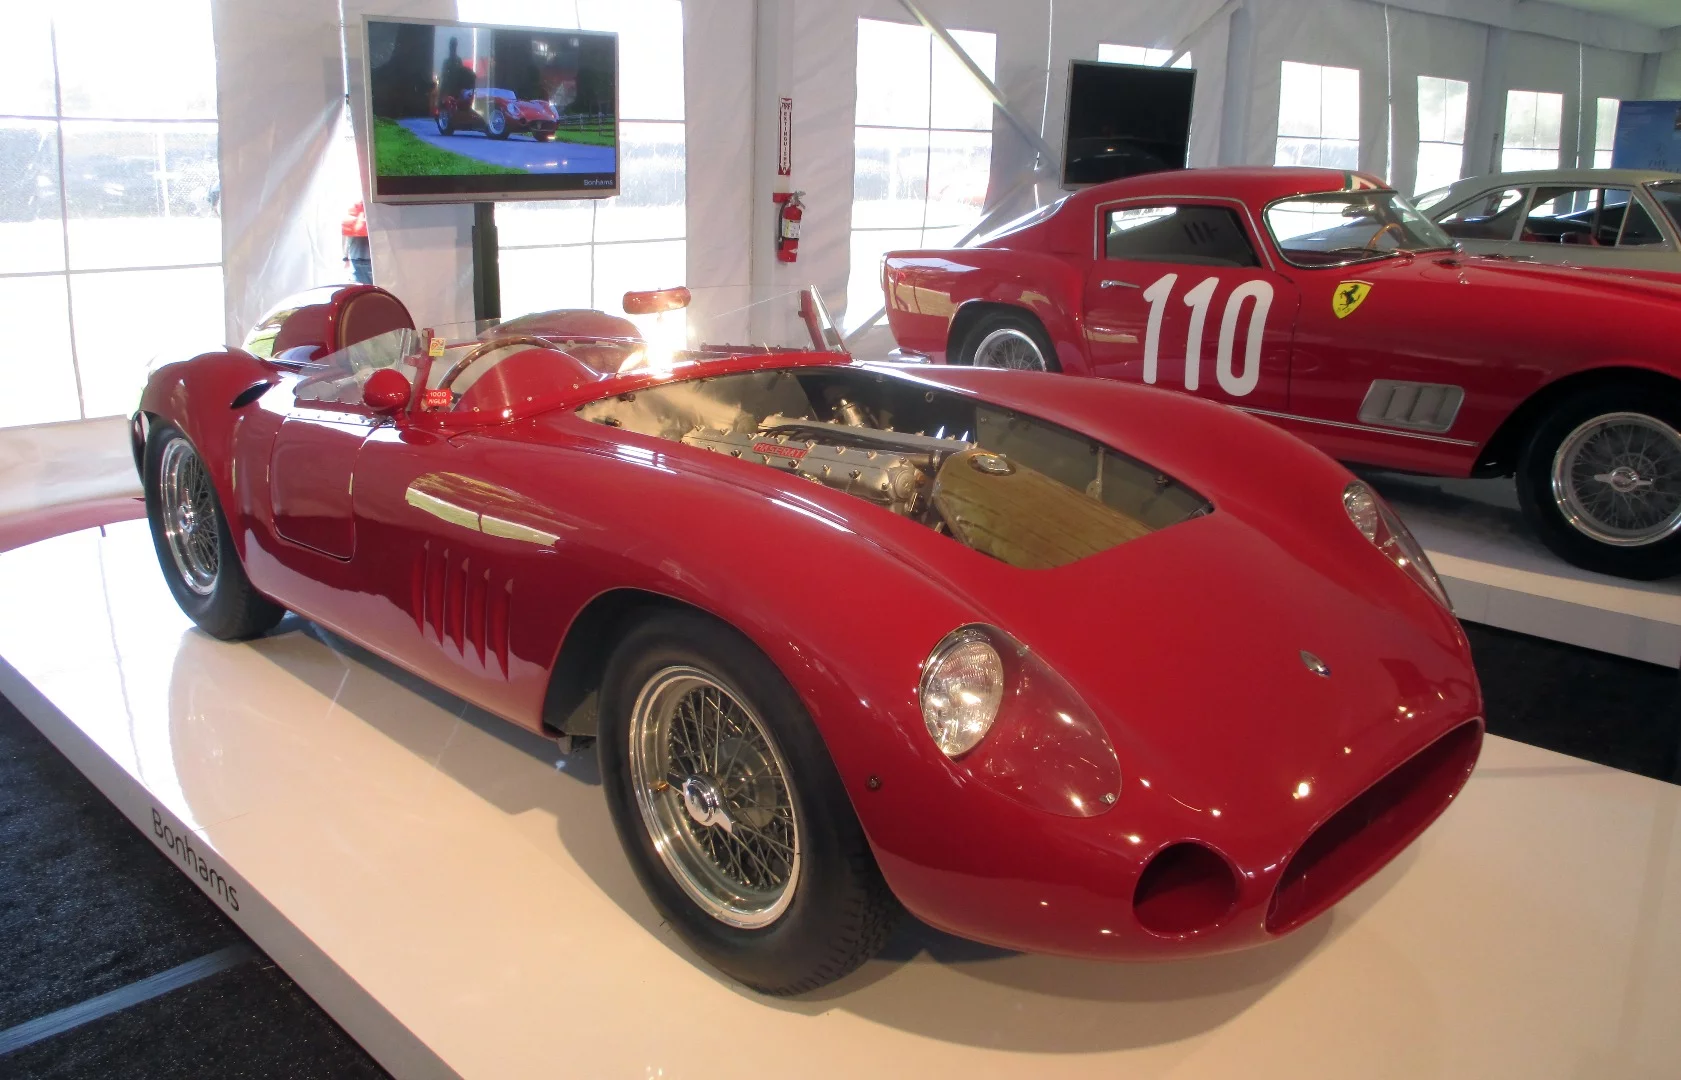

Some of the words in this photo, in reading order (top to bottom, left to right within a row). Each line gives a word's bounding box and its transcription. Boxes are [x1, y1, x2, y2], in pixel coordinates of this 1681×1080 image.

[1142, 273, 1274, 396] 110
[754, 443, 807, 459] MASERATI
[152, 807, 240, 912] Bonhams
